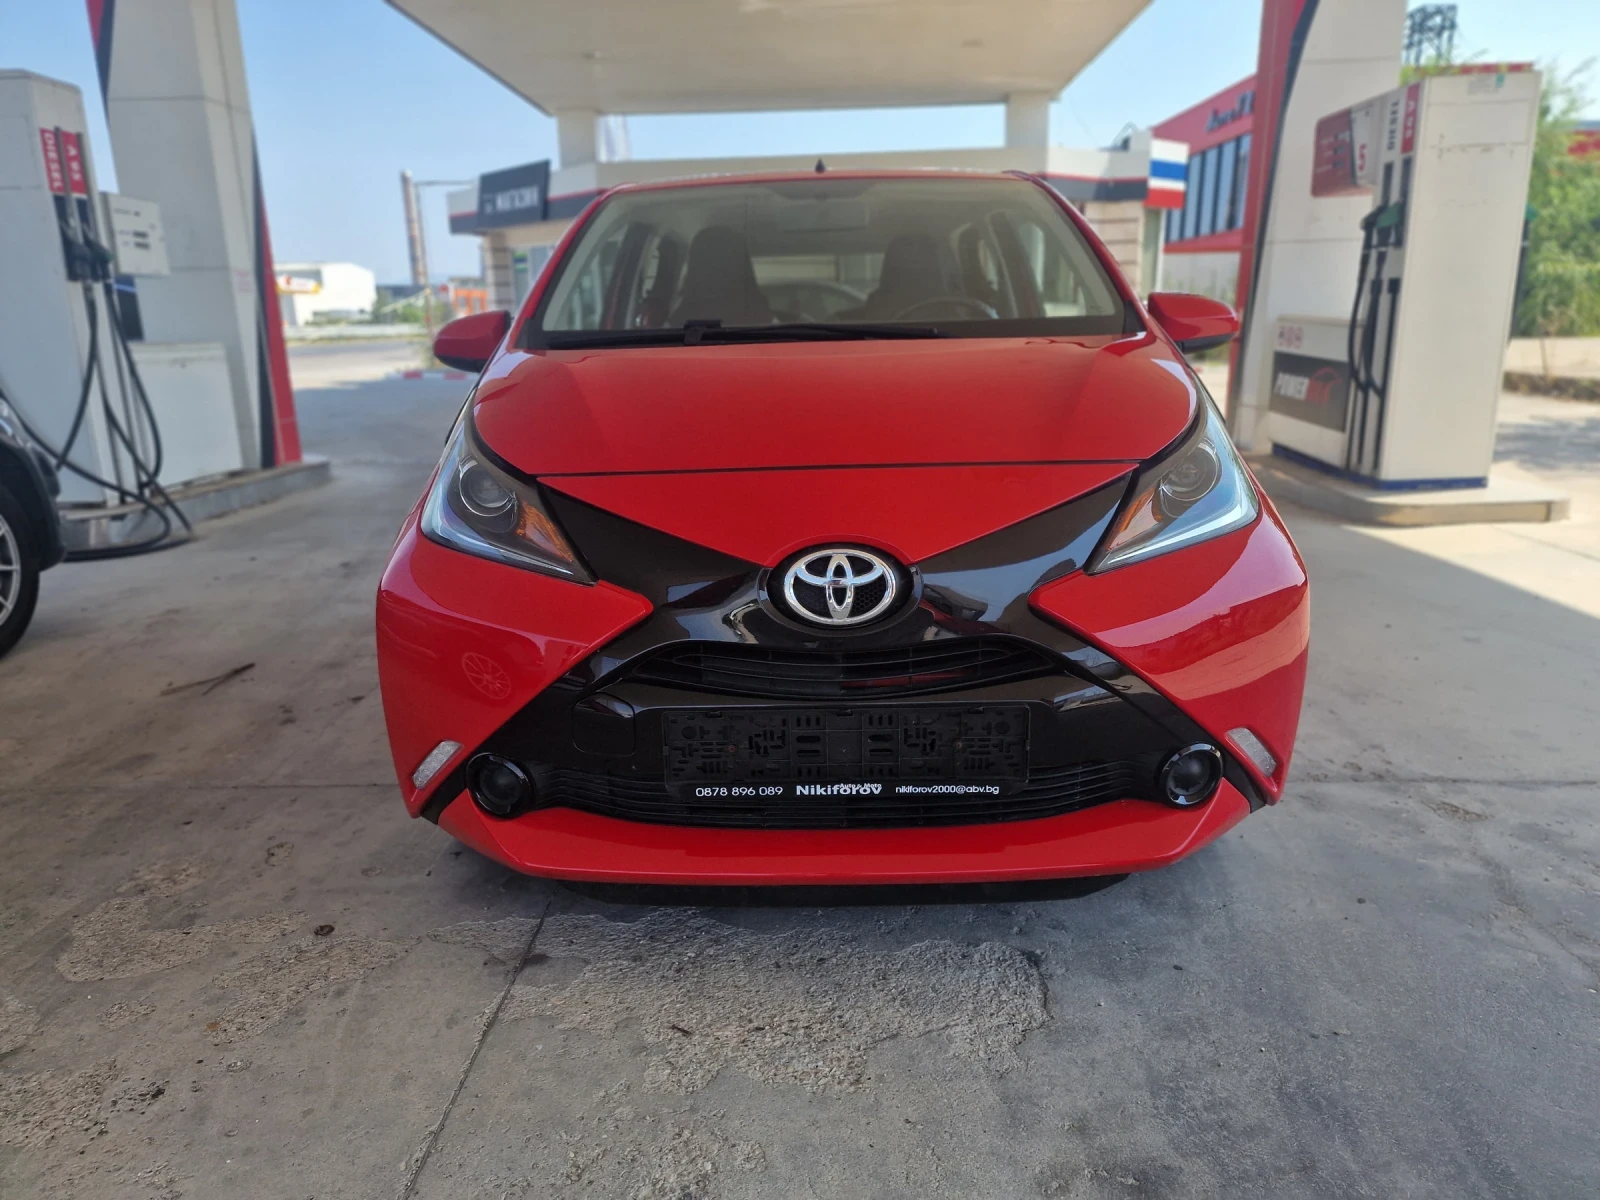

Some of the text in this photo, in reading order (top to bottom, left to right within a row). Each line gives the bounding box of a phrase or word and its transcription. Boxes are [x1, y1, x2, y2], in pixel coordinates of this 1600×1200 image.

[44, 131, 64, 189] DIESEL
[695, 784, 1000, 797] 0878 896 089 Nikiforov nikiforov2000@abv.bg
